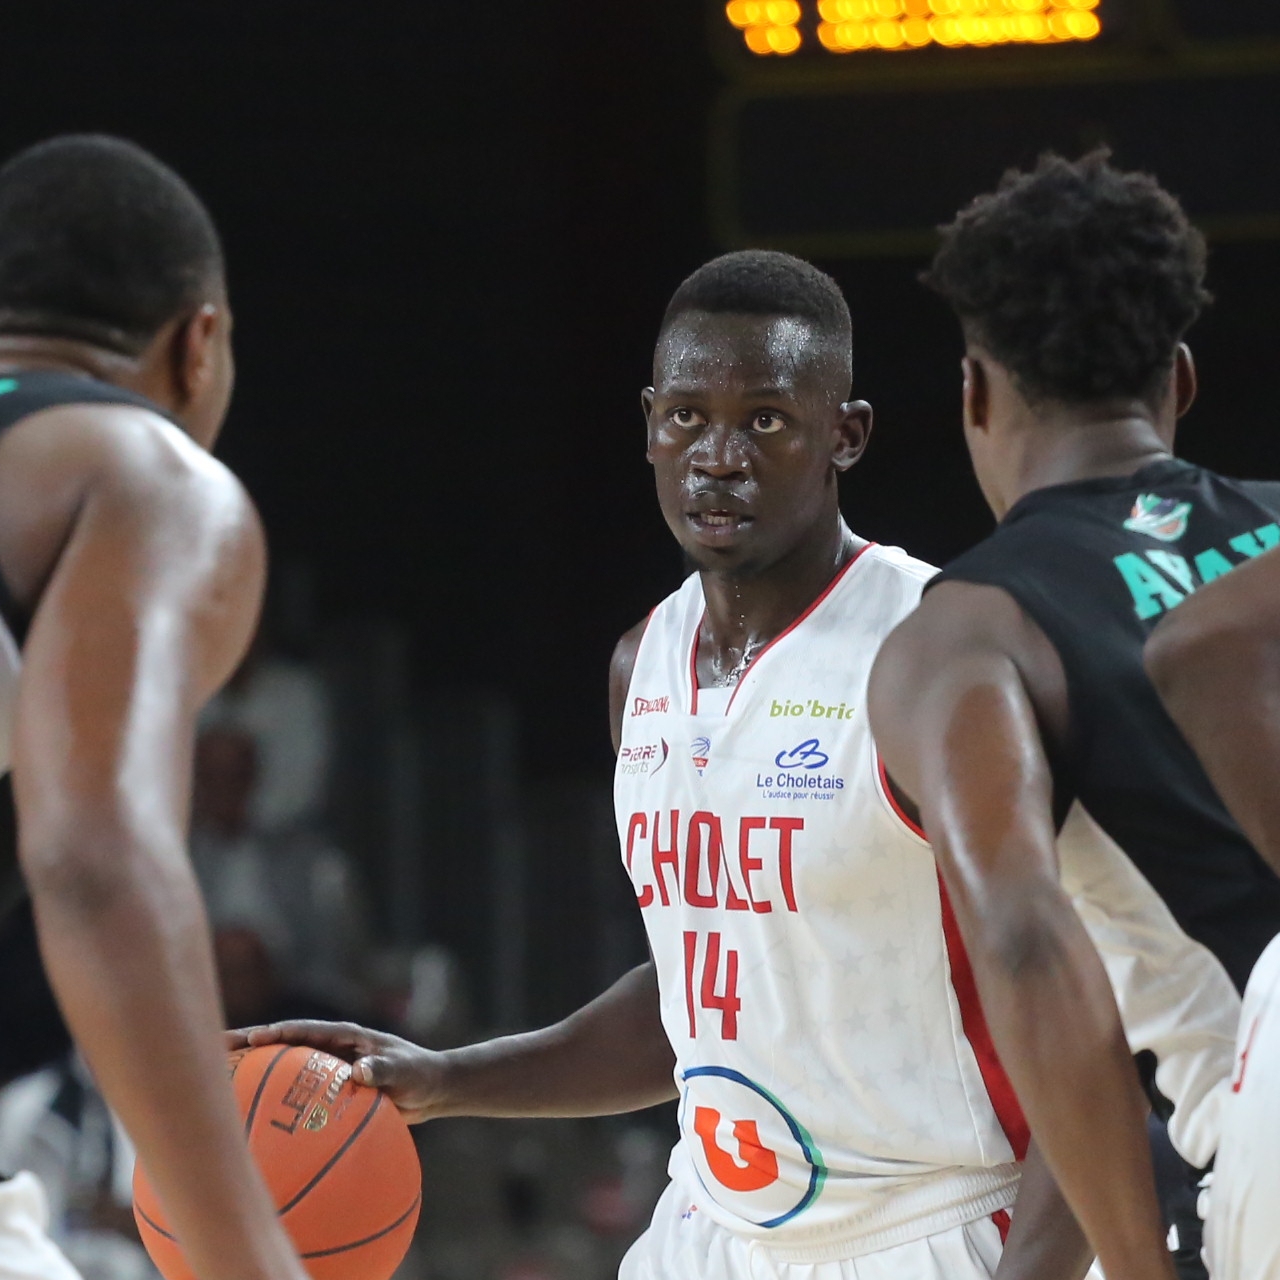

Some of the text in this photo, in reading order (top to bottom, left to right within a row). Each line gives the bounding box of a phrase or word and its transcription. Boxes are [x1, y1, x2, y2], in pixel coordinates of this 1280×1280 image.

[769, 700, 855, 720] bio'bric
[756, 772, 845, 790] Le Choletais
[762, 790, 792, 799] L'audace
[626, 809, 805, 914] CHOLET
[683, 931, 741, 1041] 14
